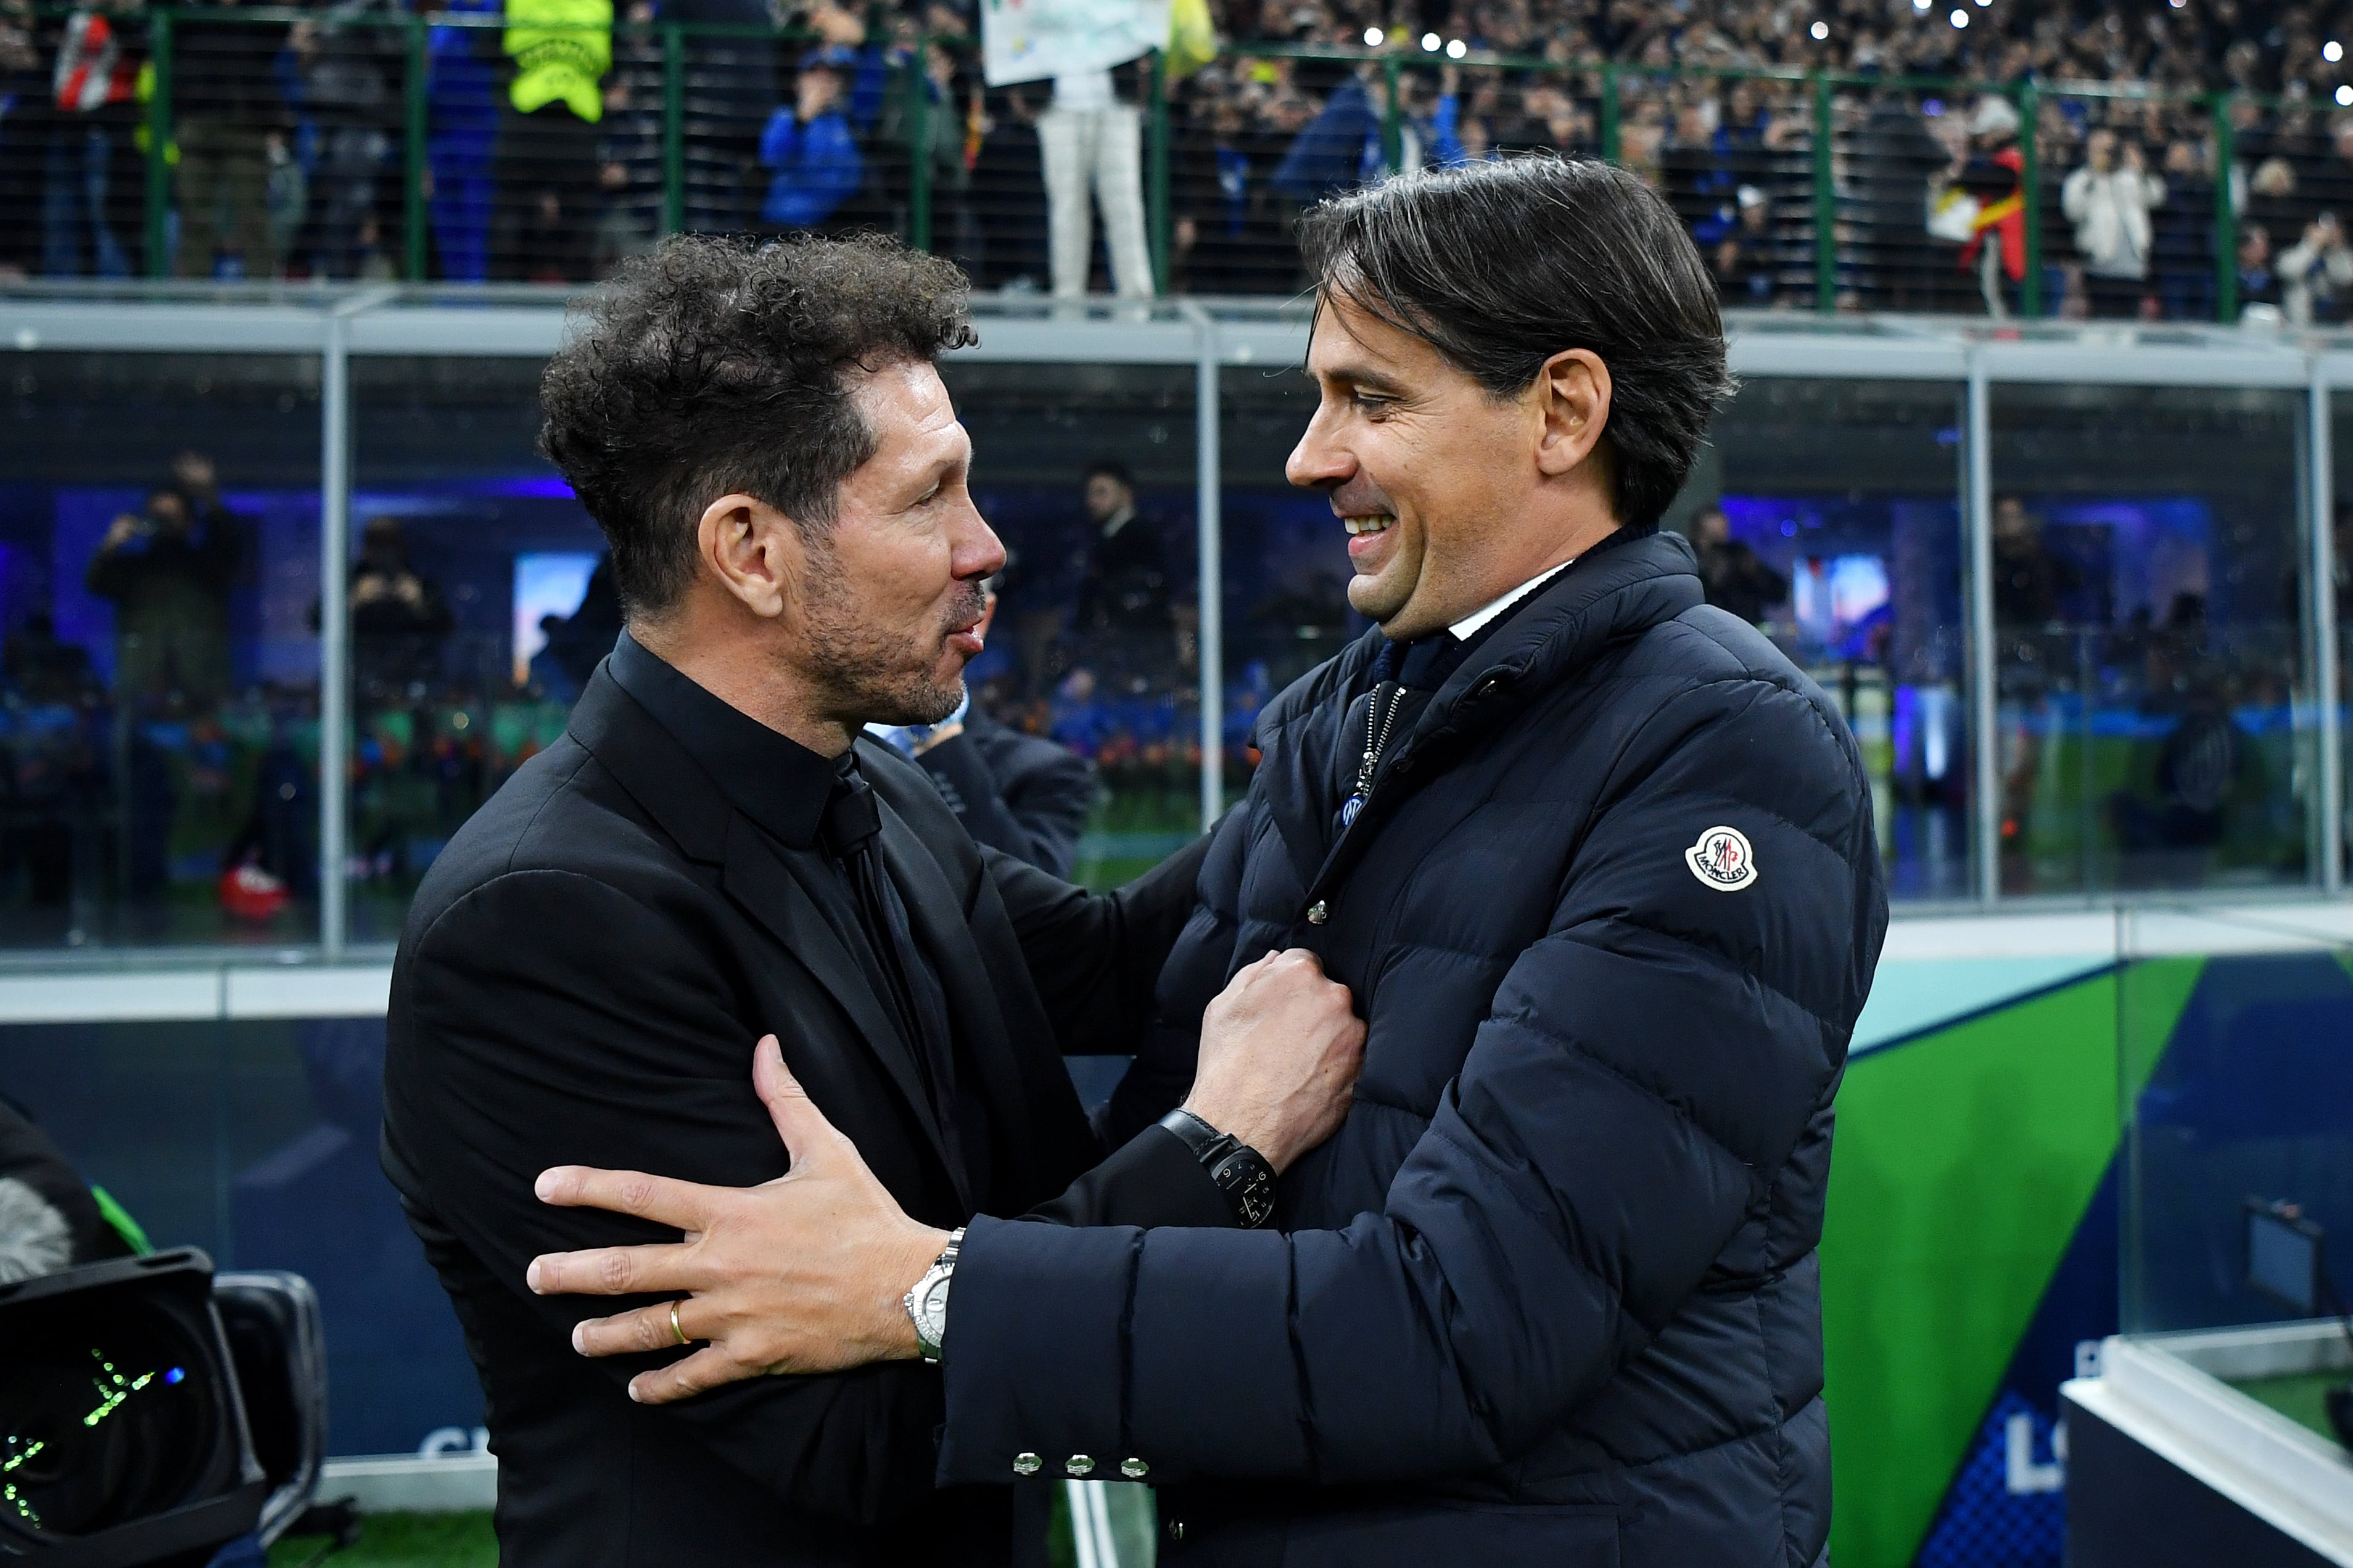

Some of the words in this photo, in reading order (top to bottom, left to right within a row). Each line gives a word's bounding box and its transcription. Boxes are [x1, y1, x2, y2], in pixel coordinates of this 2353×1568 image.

[1699, 856, 1745, 880] MONCLER
[1222, 1168, 1231, 1178] 6
[1258, 1171, 1266, 1181] 9
